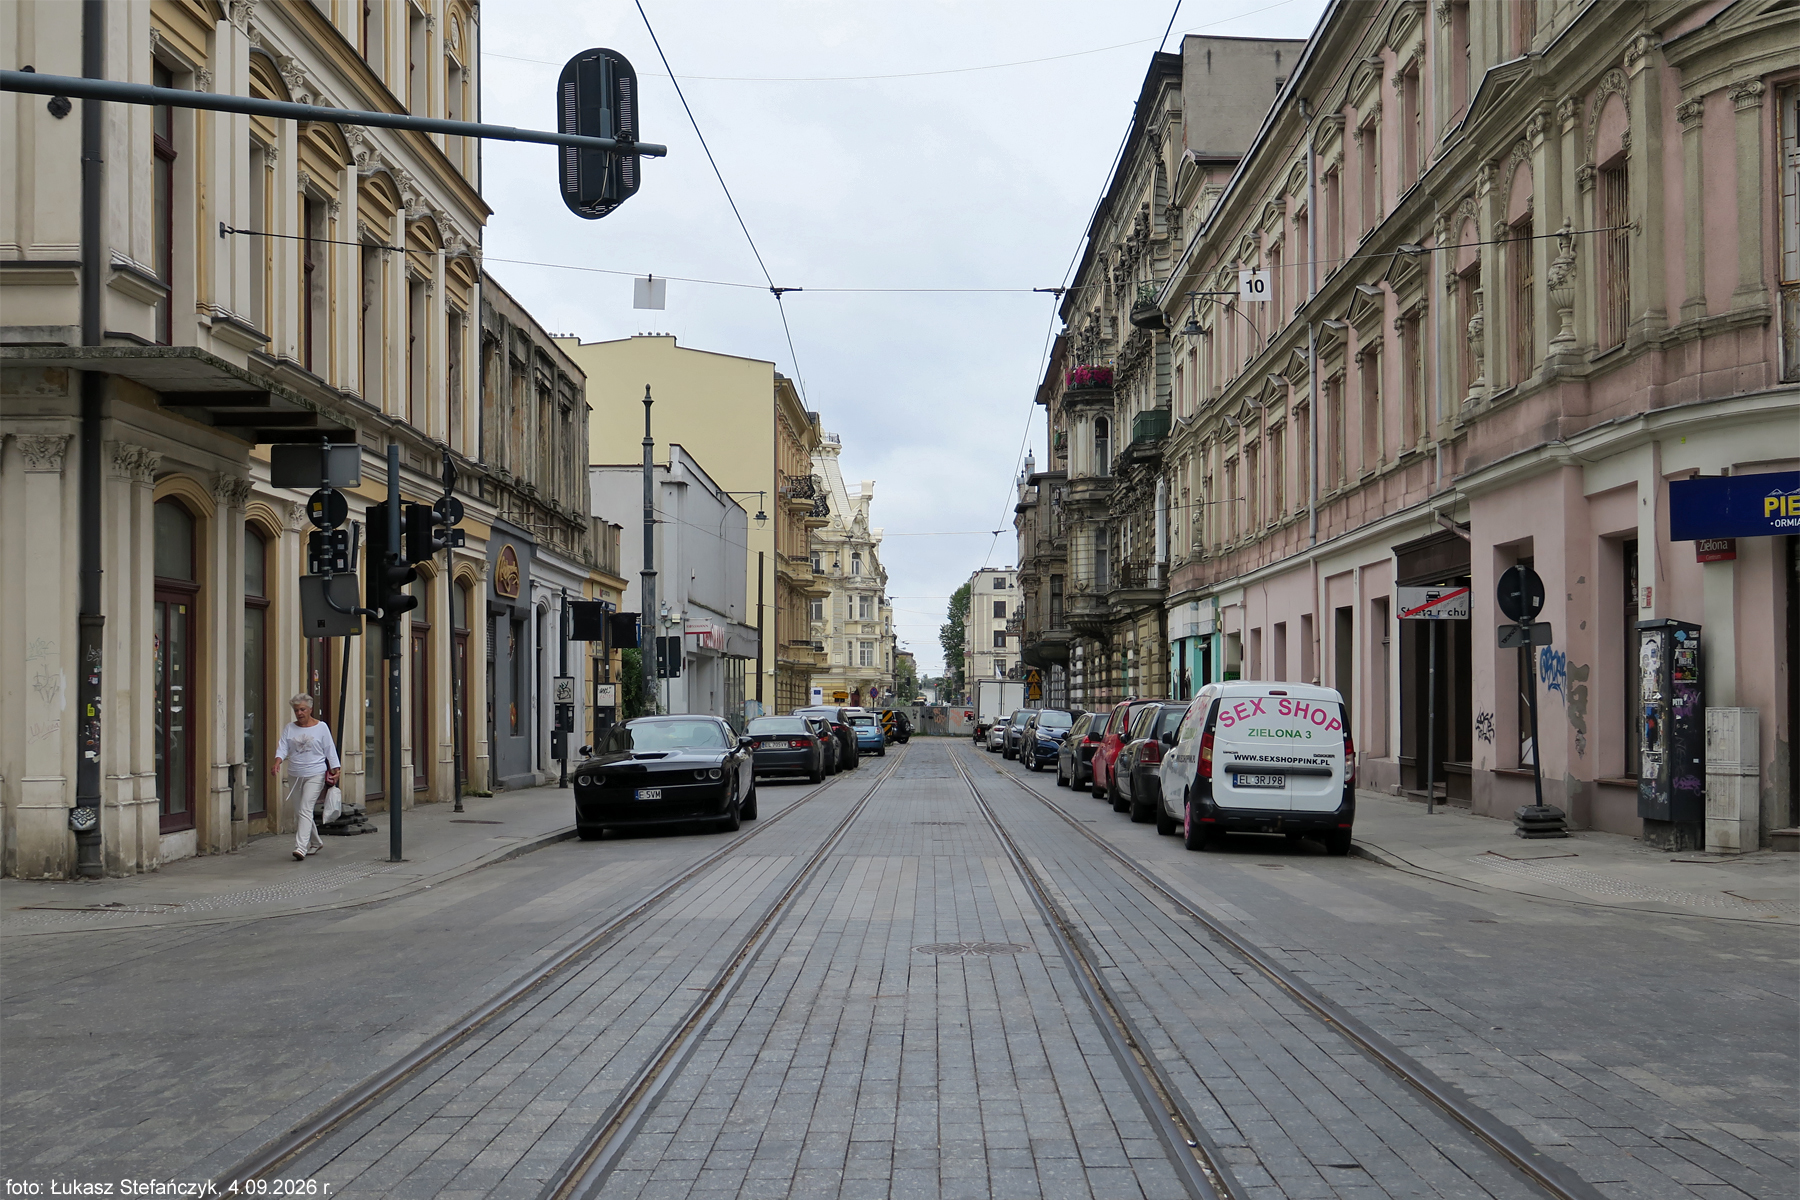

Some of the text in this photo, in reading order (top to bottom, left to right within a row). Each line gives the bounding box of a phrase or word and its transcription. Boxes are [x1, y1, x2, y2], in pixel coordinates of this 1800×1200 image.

[1245, 279, 1265, 294] 10
[1763, 495, 1800, 518] PIE
[1699, 539, 1728, 552] Zielona
[1219, 697, 1267, 728] SEX
[1278, 698, 1342, 732] SHOP
[1247, 728, 1312, 739] ZIELONA 3
[1233, 754, 1331, 766] WWW.SEXSHOPPINK.PL
[1239, 774, 1283, 786] EL 3RJ98
[638, 790, 661, 799] E SVM
